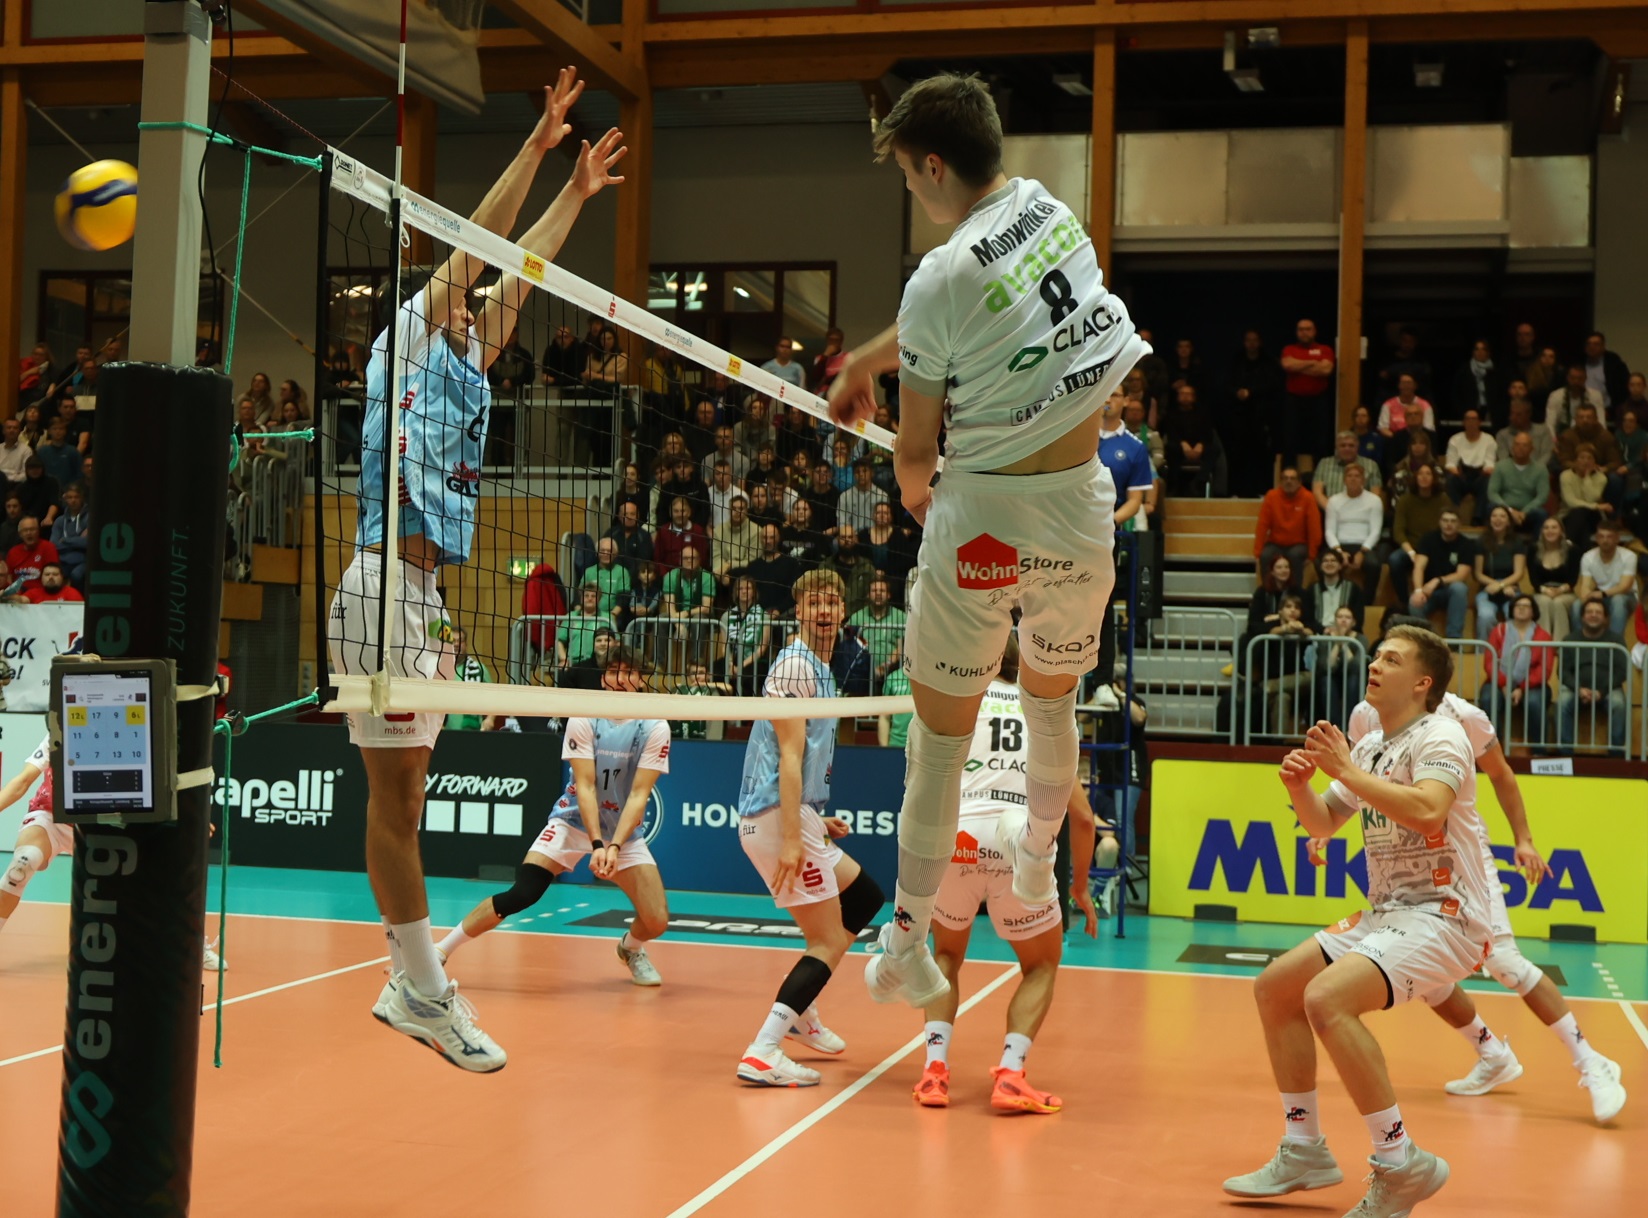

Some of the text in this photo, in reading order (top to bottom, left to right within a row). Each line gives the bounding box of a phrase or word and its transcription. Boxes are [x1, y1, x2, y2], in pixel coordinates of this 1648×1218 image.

[970, 198, 1058, 268] Mohwinkel
[1039, 268, 1079, 328] 8
[384, 725, 416, 736] mbs.de
[988, 716, 1023, 753] 13
[210, 768, 335, 818] apelli
[436, 773, 528, 798] FORWARD
[254, 808, 333, 827] SPORT
[682, 802, 741, 829] HO
[834, 808, 901, 836] RES
[1187, 817, 1606, 914] MIKSA
[933, 904, 969, 922] UHLMANN
[1003, 904, 1055, 927] SKODA
